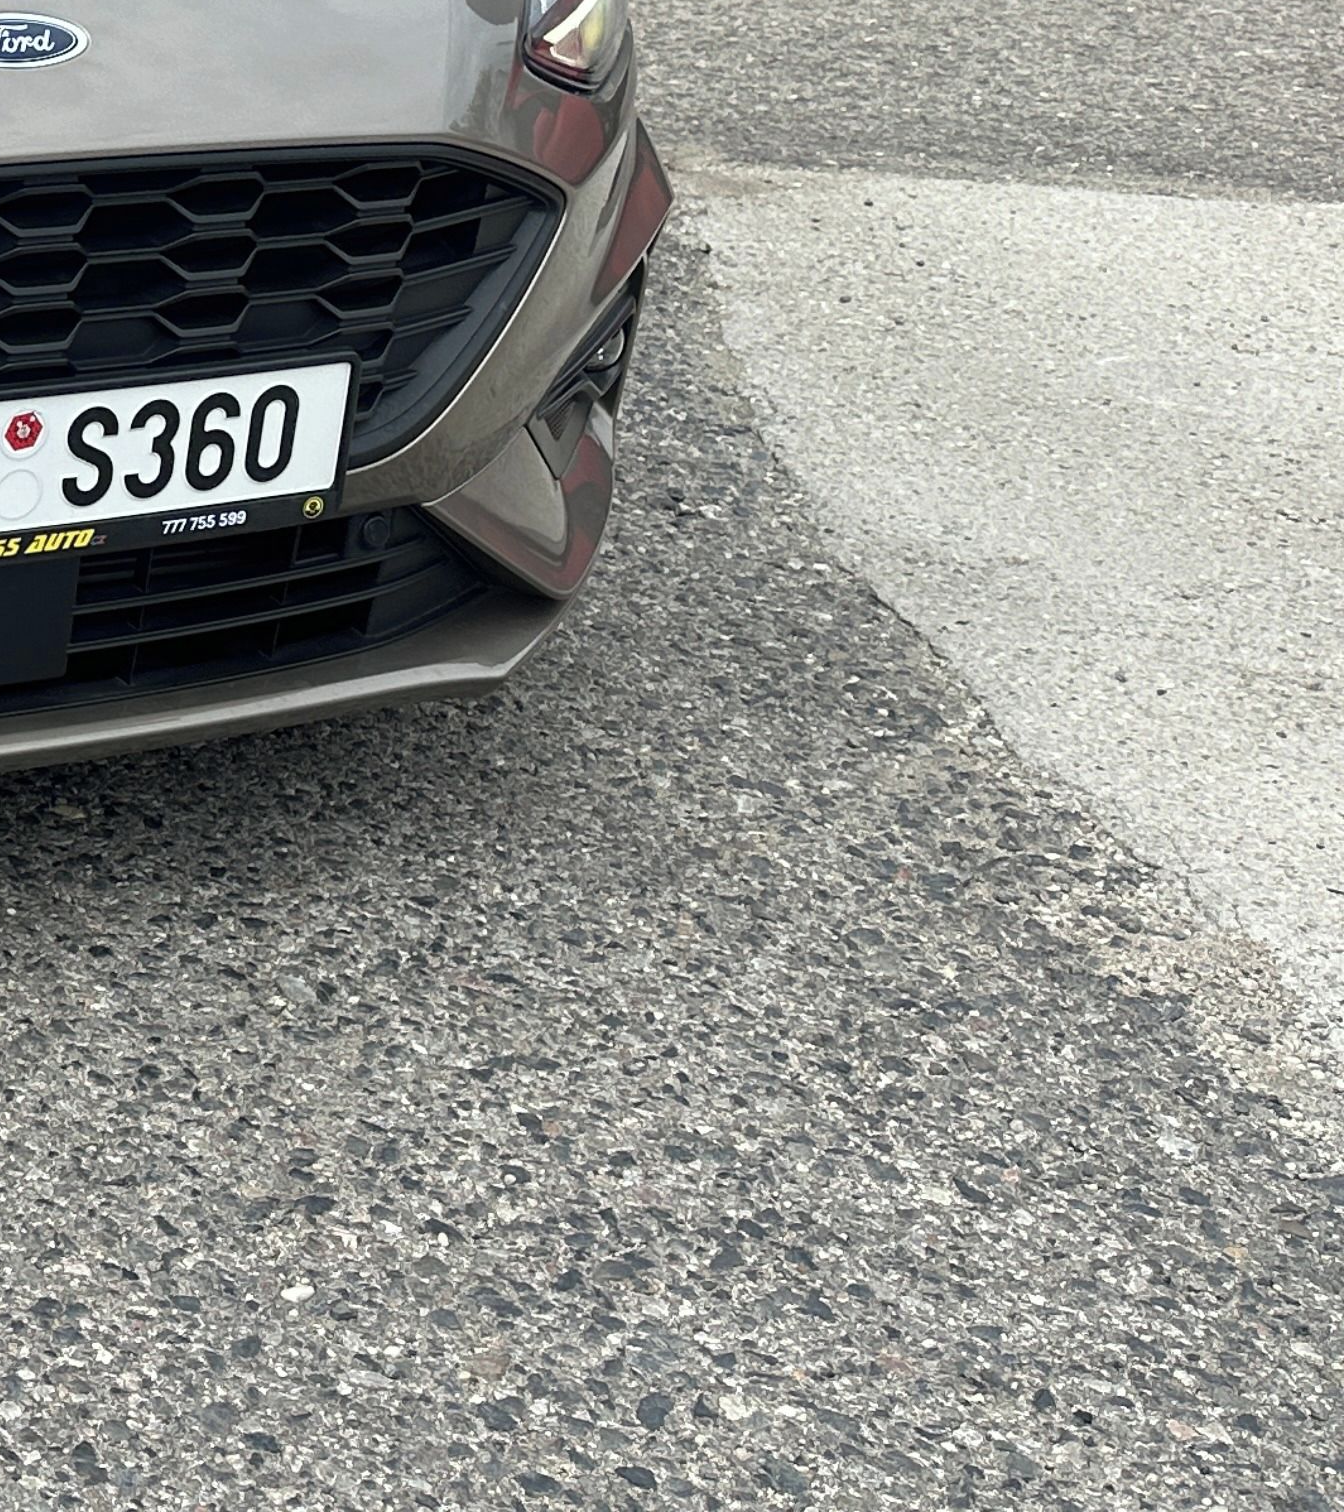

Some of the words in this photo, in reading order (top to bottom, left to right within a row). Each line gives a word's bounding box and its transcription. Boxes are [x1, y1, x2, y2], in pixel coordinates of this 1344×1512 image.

[60, 384, 300, 507] S360
[161, 518, 188, 535] 777
[189, 514, 216, 531] 755
[218, 510, 247, 528] 599
[23, 528, 96, 555] AUTO
